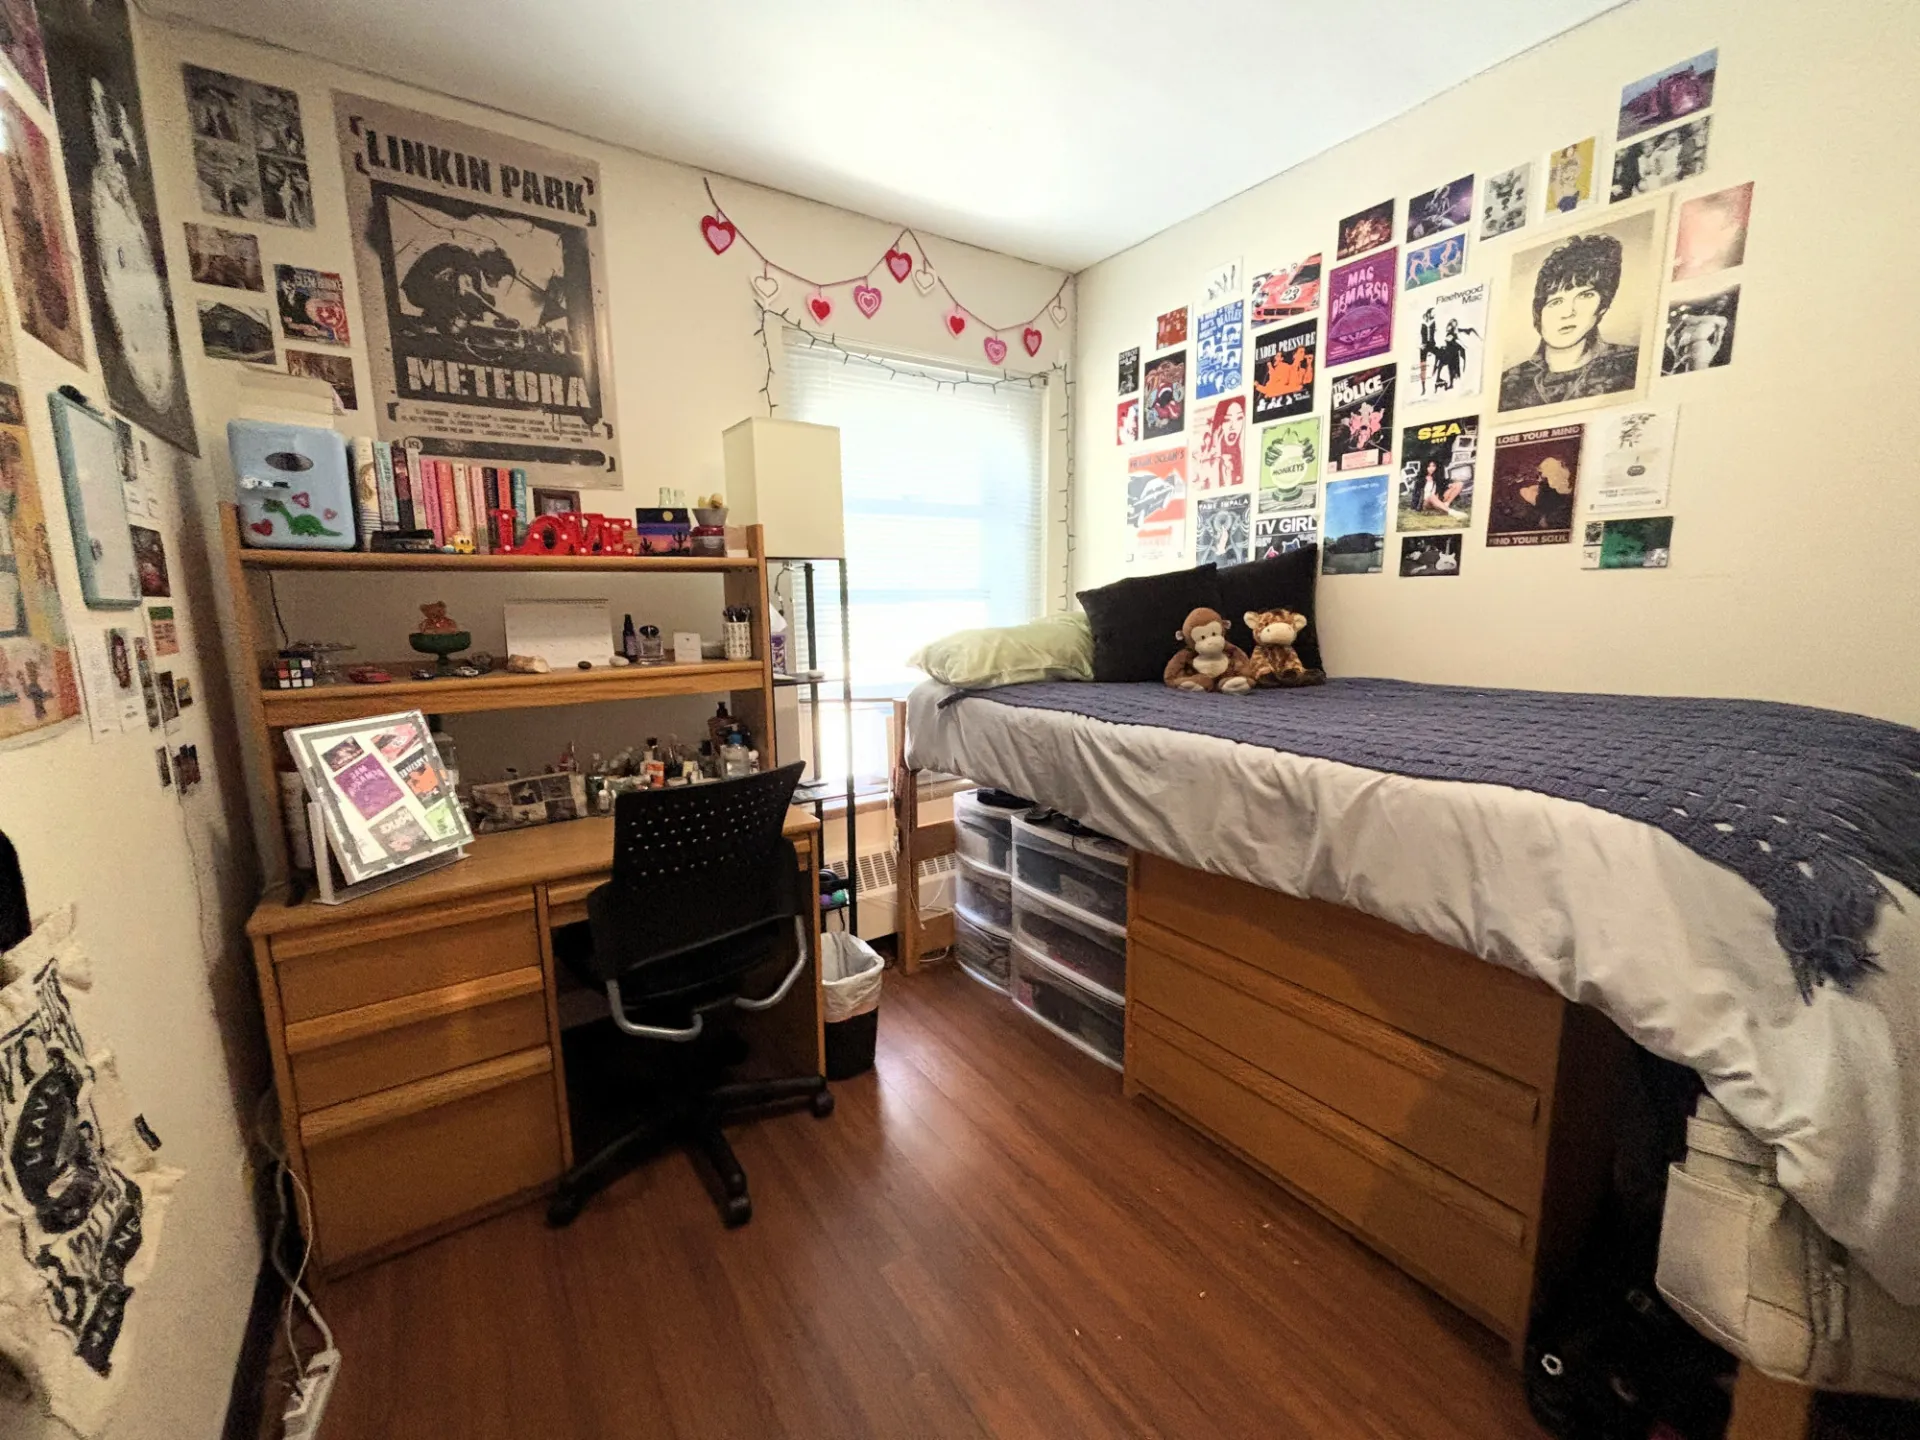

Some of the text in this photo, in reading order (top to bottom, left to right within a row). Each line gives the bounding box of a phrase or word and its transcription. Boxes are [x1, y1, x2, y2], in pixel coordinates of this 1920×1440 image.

[365, 129, 587, 217] LINKIN PARK
[1347, 266, 1374, 287] MAC
[1281, 286, 1300, 301] 23
[1331, 281, 1389, 321] DEMARCO
[1436, 284, 1484, 305] Fleetwood
[1461, 293, 1483, 305] Mac
[1278, 331, 1316, 352] PRESSURE
[406, 356, 592, 408] METEORA
[1333, 379, 1349, 392] THE
[1333, 375, 1383, 408] POLICE
[1417, 423, 1461, 440] SZA
[1498, 426, 1580, 445] LOSE YOUR MIND
[1272, 462, 1304, 475] MONKEYS
[1220, 498, 1249, 508] IMPALA
[1256, 516, 1317, 535] TV GIRL
[1513, 535, 1538, 544] YOUR
[1541, 533, 1568, 543] SOUL
